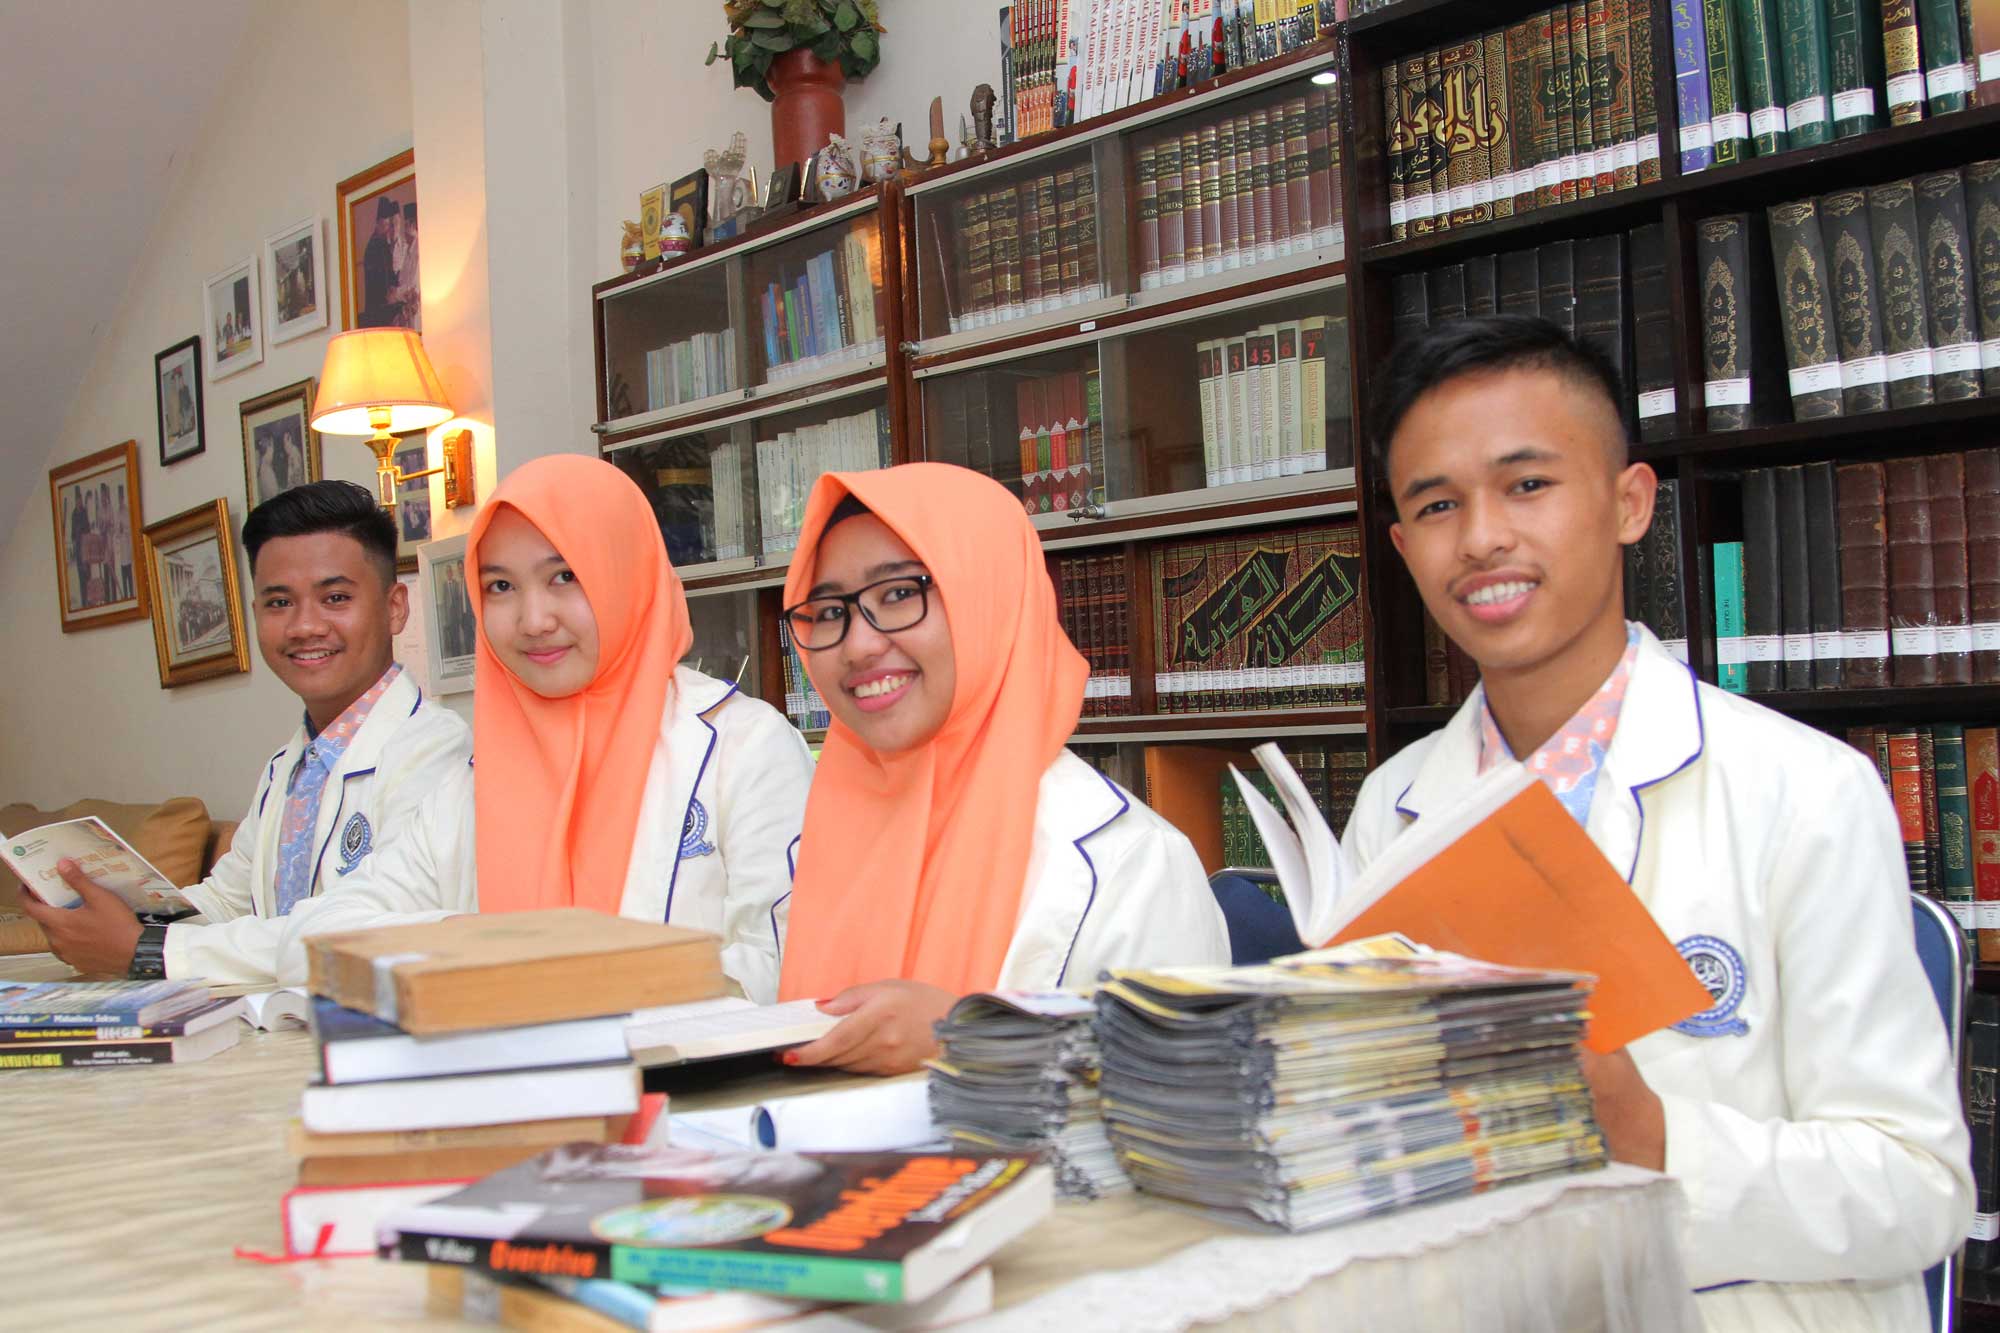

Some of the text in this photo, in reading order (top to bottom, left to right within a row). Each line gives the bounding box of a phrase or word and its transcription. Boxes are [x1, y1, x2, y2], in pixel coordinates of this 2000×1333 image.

[1098, 12, 1109, 64] ALAUDDIN
[1111, 9, 1123, 60] ALAUDDIN
[1125, 5, 1137, 56] ALAUDDIN
[1087, 18, 1097, 68] ALAUDDIN
[1250, 348, 1259, 364] 4
[1261, 348, 1271, 364] 5
[1280, 342, 1291, 357] 6
[1307, 341, 1316, 357] 7
[1231, 354, 1240, 371] 3
